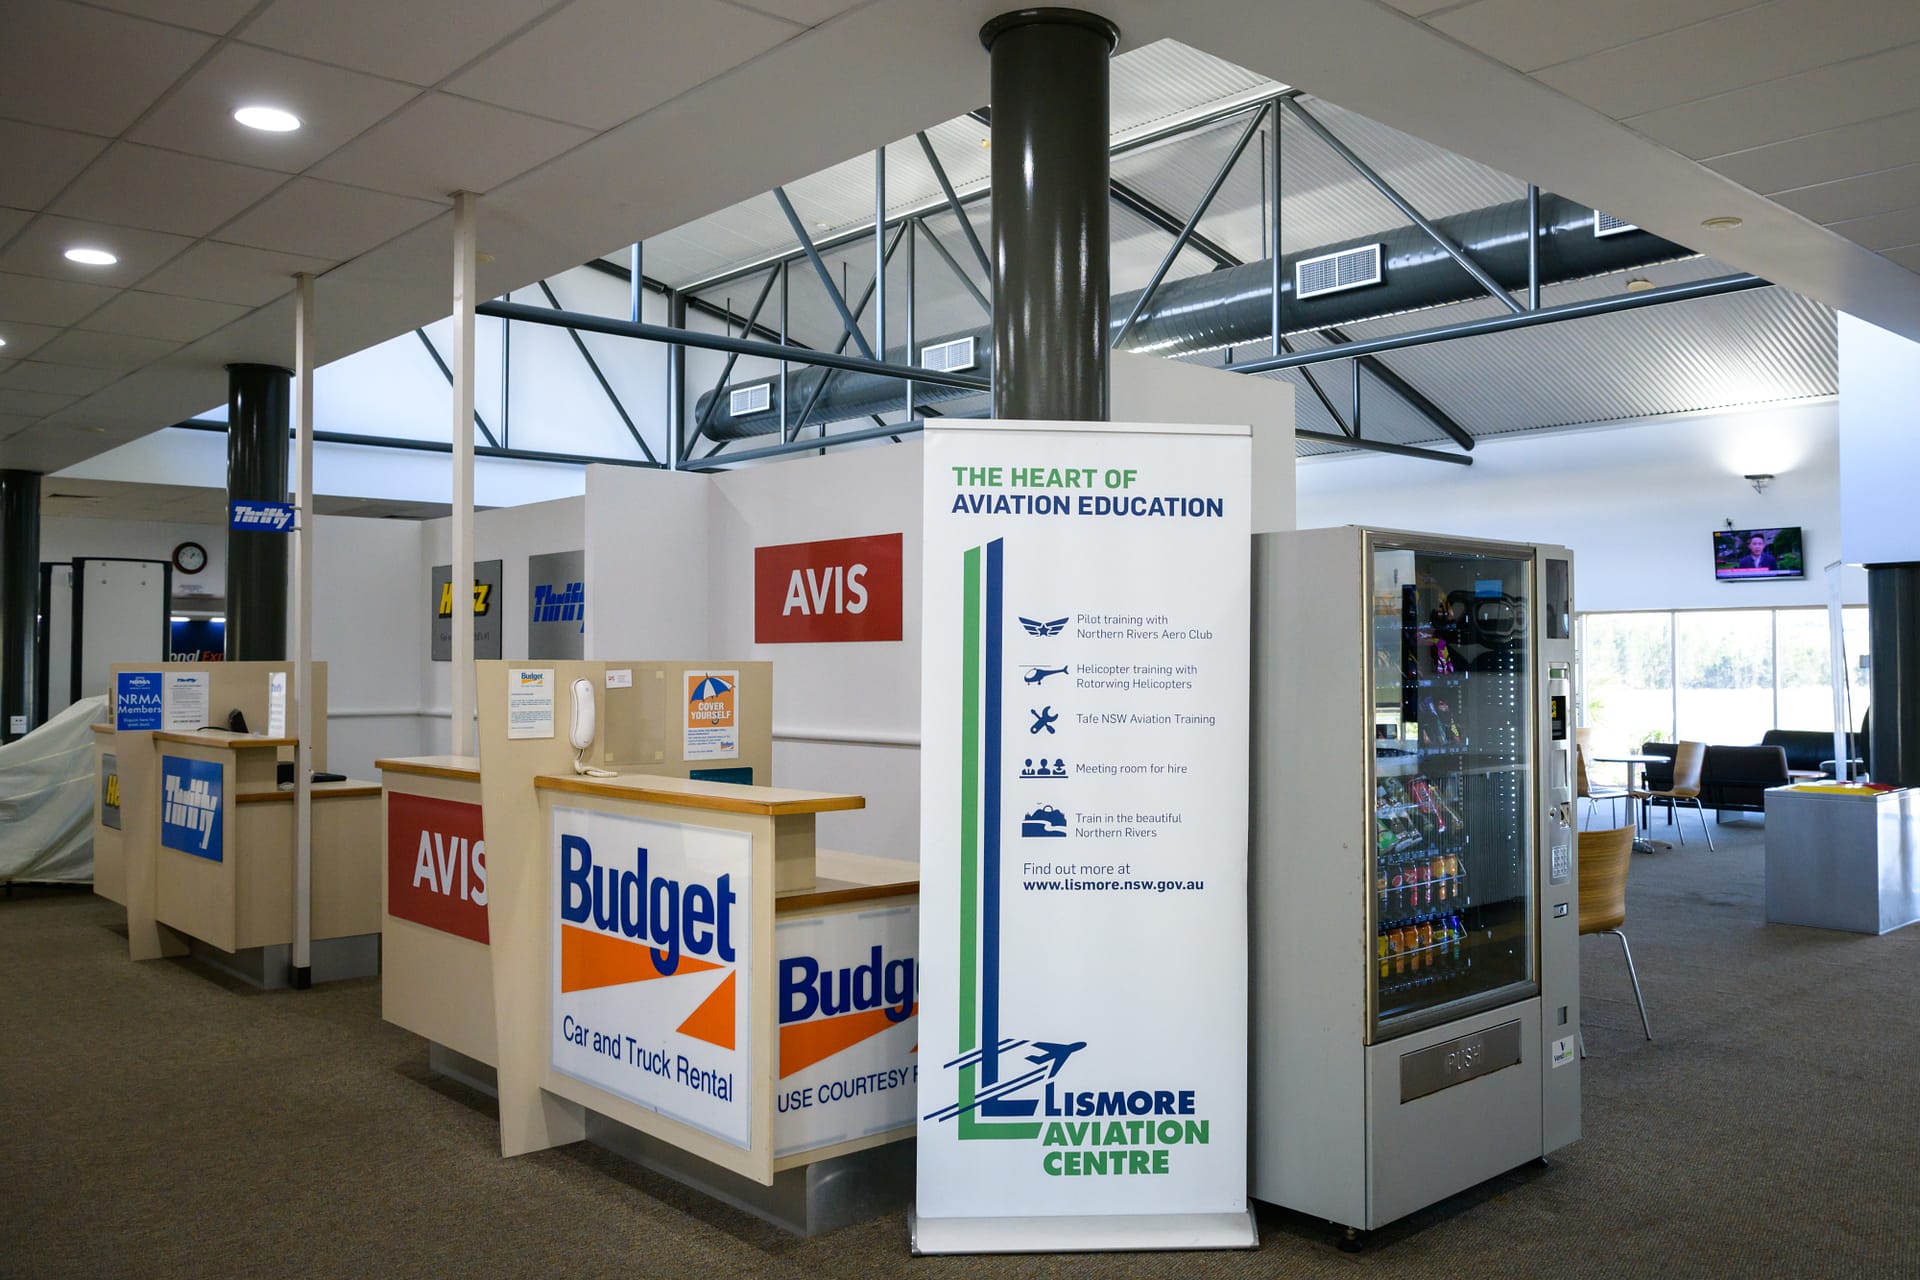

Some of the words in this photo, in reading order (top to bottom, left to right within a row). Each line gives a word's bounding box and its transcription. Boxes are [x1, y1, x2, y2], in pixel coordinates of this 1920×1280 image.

[952, 467, 1003, 487] THE
[1011, 468, 1098, 488] HEART
[1105, 469, 1137, 489] OF
[952, 494, 1070, 515] AVIATION
[1079, 496, 1223, 517] EDUCATION
[234, 506, 291, 529] Thrifty
[782, 563, 868, 616] AVIS
[1078, 614, 1101, 624] Pilot
[1104, 614, 1144, 627] training
[1146, 615, 1168, 624] with
[1078, 629, 1123, 639] Northern
[1127, 629, 1158, 640] Rivers
[1162, 629, 1187, 639] Aero
[1188, 630, 1212, 640] Club
[1077, 664, 1130, 676] Helicopter
[1133, 664, 1172, 676] training
[1176, 665, 1197, 674] with
[1077, 679, 1129, 691] Rotorwing
[1133, 679, 1192, 690] Helicopters
[118, 694, 161, 705] NRMA
[699, 702, 724, 711] COVER
[118, 704, 161, 714] Members
[691, 710, 731, 720] YOURSELF
[1076, 713, 1099, 723] Tafe
[1102, 714, 1127, 723] NSW
[1130, 714, 1171, 724] Aviation
[1174, 713, 1215, 726] Training
[1076, 763, 1117, 775] Meeting
[1119, 765, 1147, 773] room
[1150, 763, 1164, 773] for
[1167, 764, 1187, 773] hire
[164, 774, 217, 850] Thrifty
[1076, 813, 1101, 823] Train
[1105, 814, 1113, 823] in
[1116, 813, 1133, 823] the
[1136, 813, 1182, 823] beautiful
[1076, 828, 1122, 838] Northern
[1125, 827, 1157, 838] Rivers
[413, 830, 488, 906] AVIS
[1024, 863, 1051, 875] Find
[1055, 864, 1076, 874] out
[1081, 866, 1114, 875] more
[1118, 864, 1130, 874] at
[1023, 879, 1203, 892] www.lismore.nsw.gov.au
[561, 834, 736, 977] Budget
[779, 945, 919, 1024] Budg
[563, 1015, 590, 1045] Car
[592, 1030, 621, 1060] and
[626, 1036, 671, 1080] Truck
[676, 1055, 733, 1102] Rental
[1448, 1044, 1481, 1072] PUSH
[778, 1088, 813, 1112] USE
[818, 1067, 909, 1104] COURTESY
[1045, 1081, 1195, 1117] LISMORE
[1042, 1119, 1210, 1146] AVIATION
[1043, 1149, 1169, 1176] CENTRE
